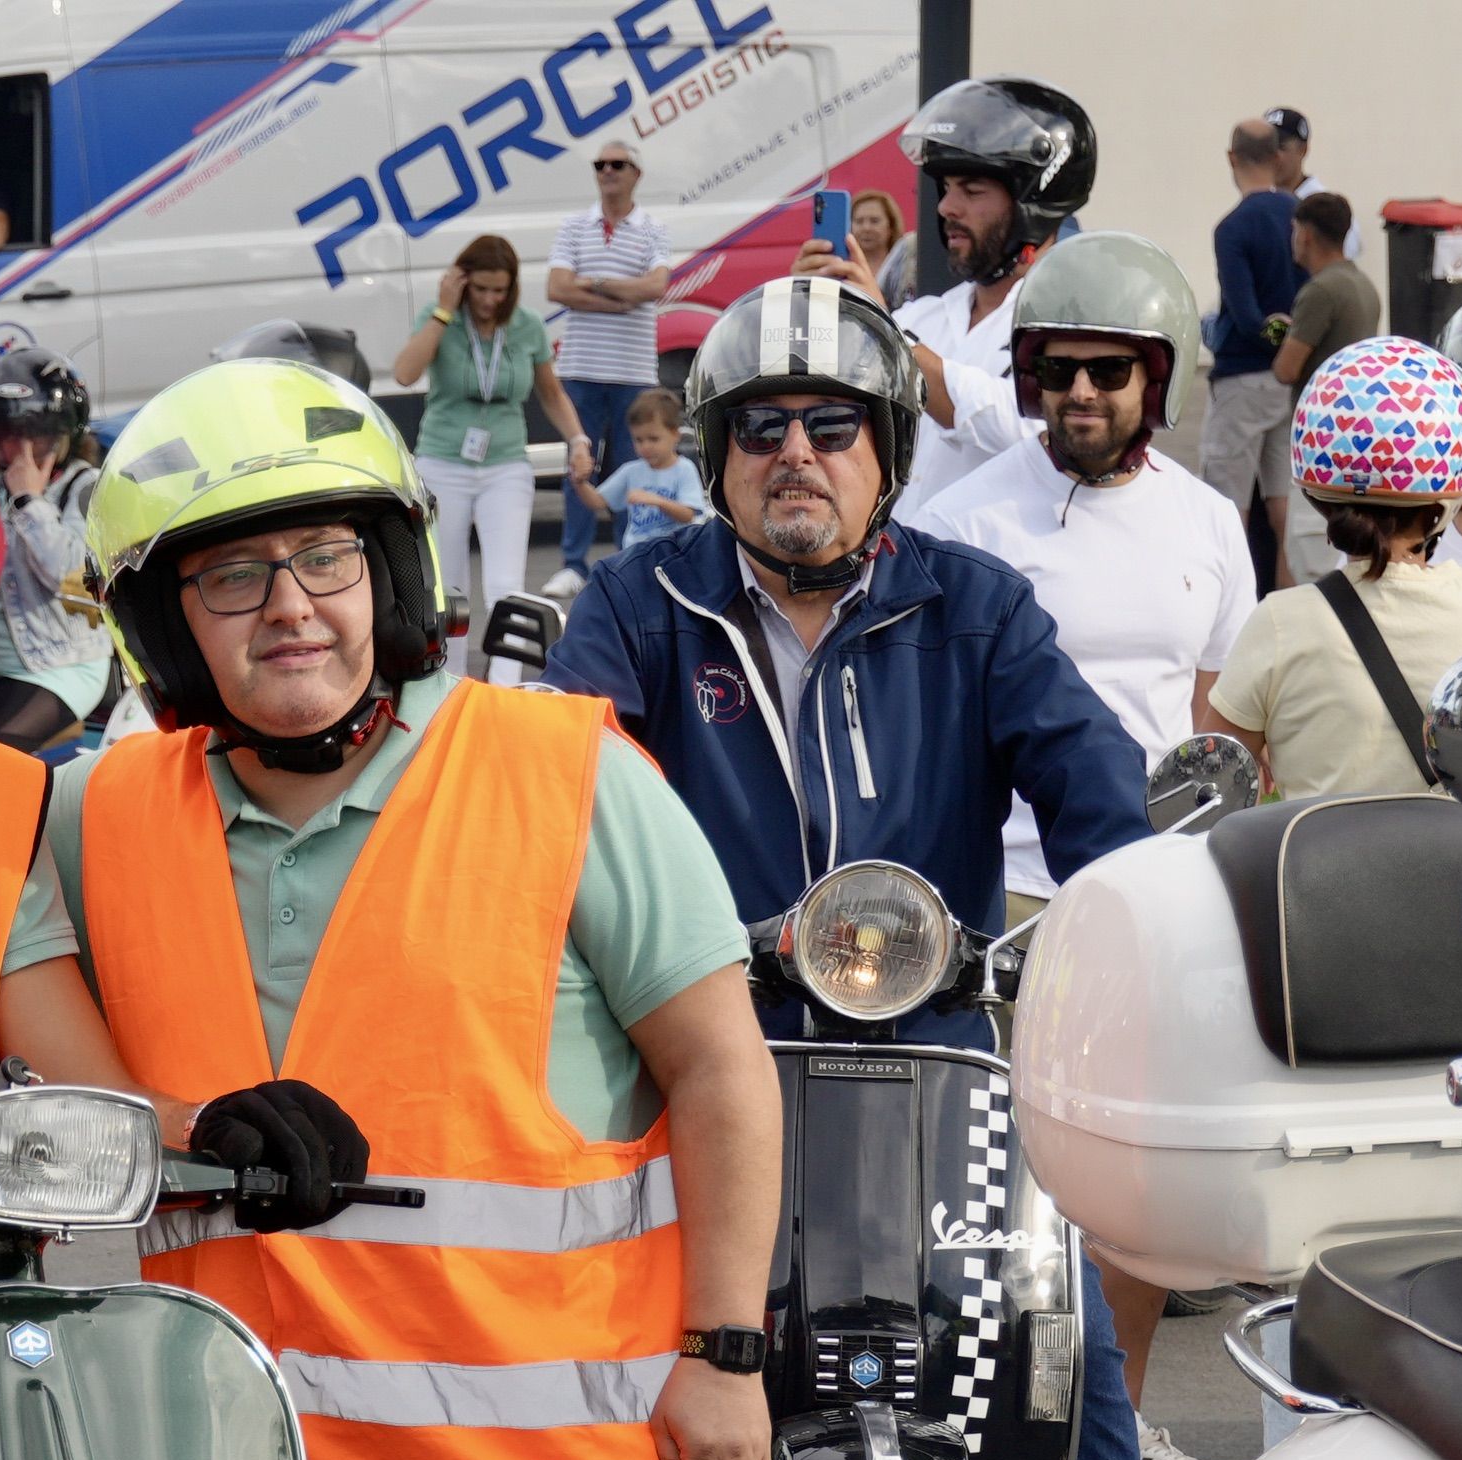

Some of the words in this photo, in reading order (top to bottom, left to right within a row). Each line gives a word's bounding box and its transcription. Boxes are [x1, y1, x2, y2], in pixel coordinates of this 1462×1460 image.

[630, 28, 791, 139] LOGISTIC
[764, 327, 833, 342] HELIX
[818, 1062, 904, 1073] MOTOVESPA
